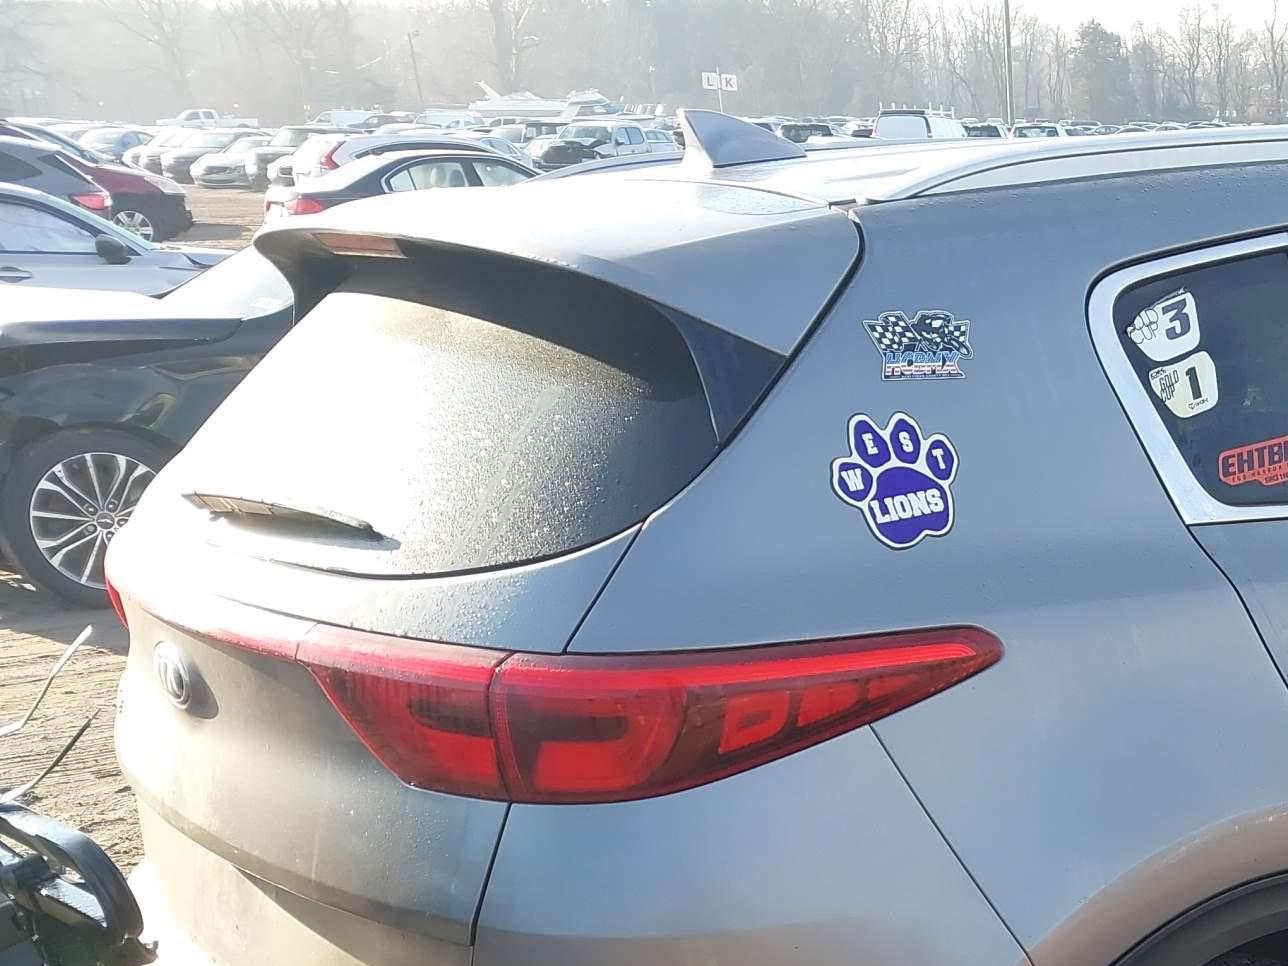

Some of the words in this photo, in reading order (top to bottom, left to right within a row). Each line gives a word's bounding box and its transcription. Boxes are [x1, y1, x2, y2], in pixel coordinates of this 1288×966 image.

[706, 76, 714, 87] L
[725, 77, 734, 88] K
[1161, 297, 1191, 341] 3
[1129, 321, 1159, 345] CUP
[885, 351, 960, 376] HCBMX
[1158, 369, 1180, 392] GOLD
[1184, 366, 1203, 401] 1
[1160, 384, 1176, 403] CUP
[840, 431, 946, 492] WEST
[869, 488, 945, 524] LIONS
